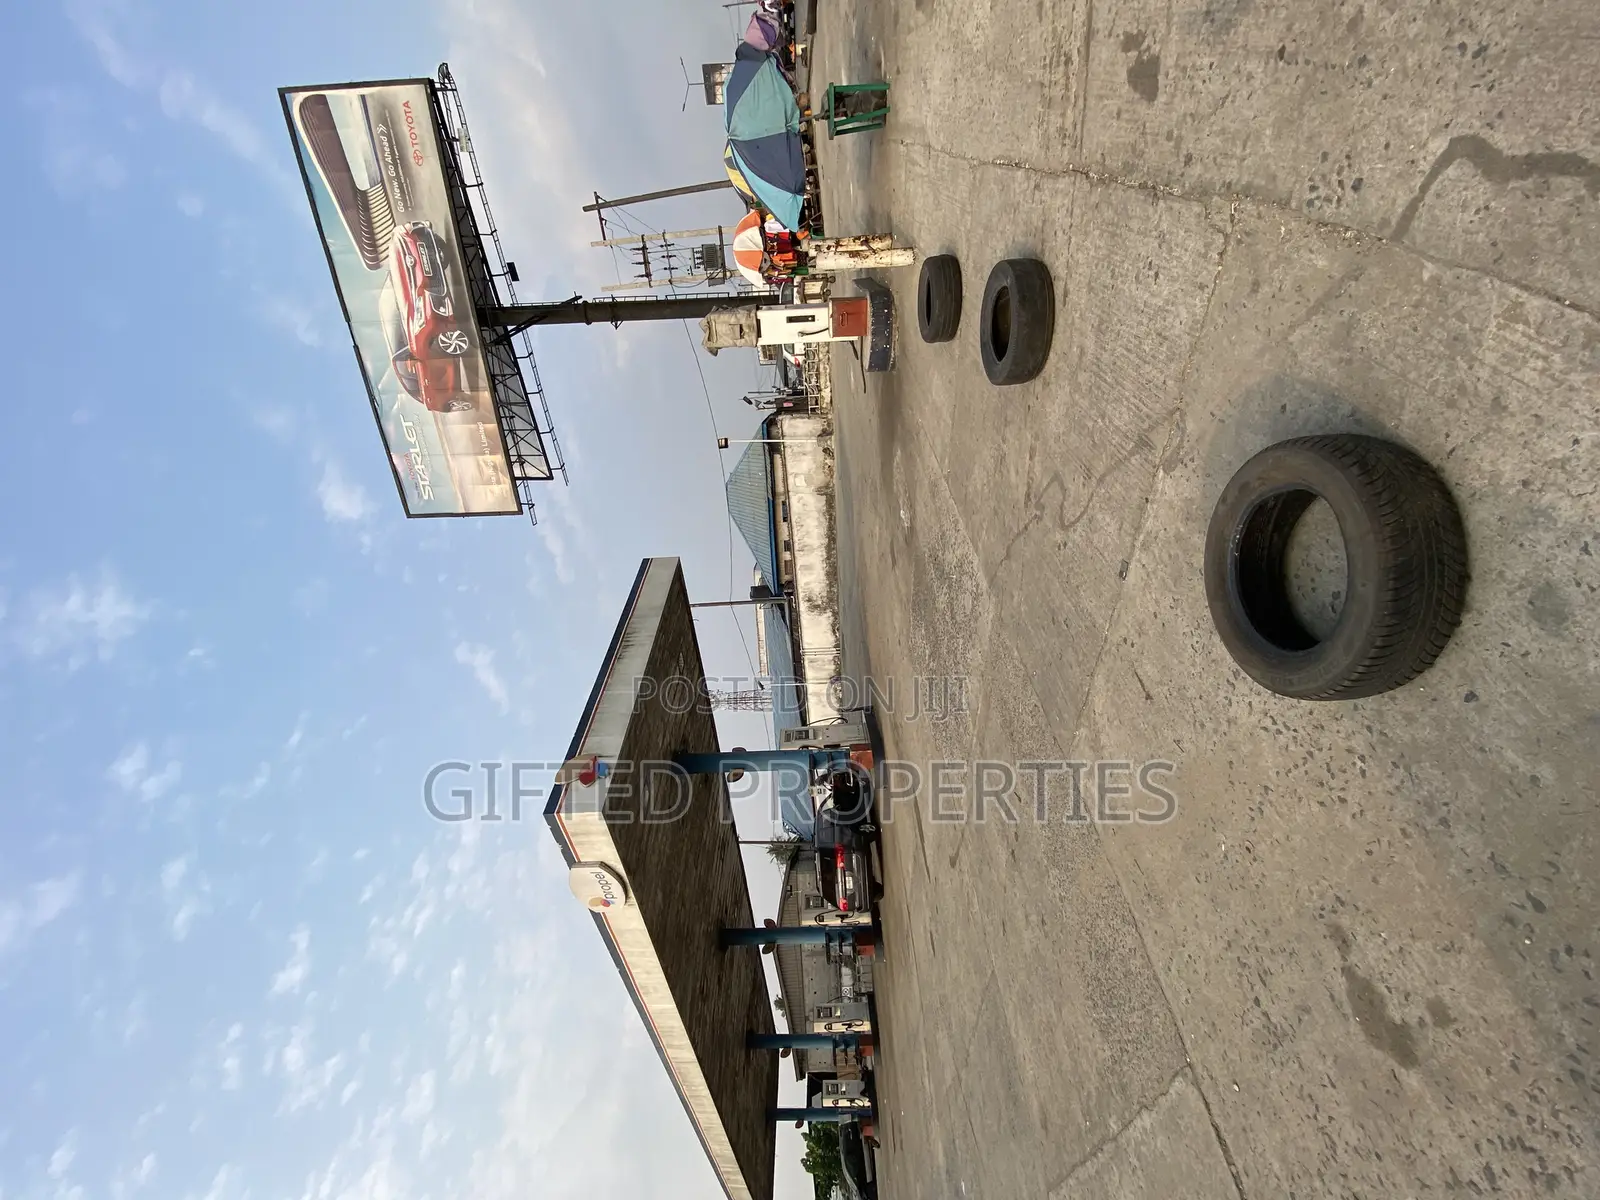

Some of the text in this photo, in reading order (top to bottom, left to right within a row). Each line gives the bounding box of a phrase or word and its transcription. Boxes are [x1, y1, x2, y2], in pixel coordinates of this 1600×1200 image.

[402, 100, 420, 148] TOYOTA
[380, 135, 393, 164] Ahead
[387, 165, 396, 177] Go
[392, 179, 402, 200] New.
[397, 201, 405, 213] Go
[477, 421, 488, 447] Limited
[400, 413, 435, 501] STARLET
[589, 871, 618, 900] propel
